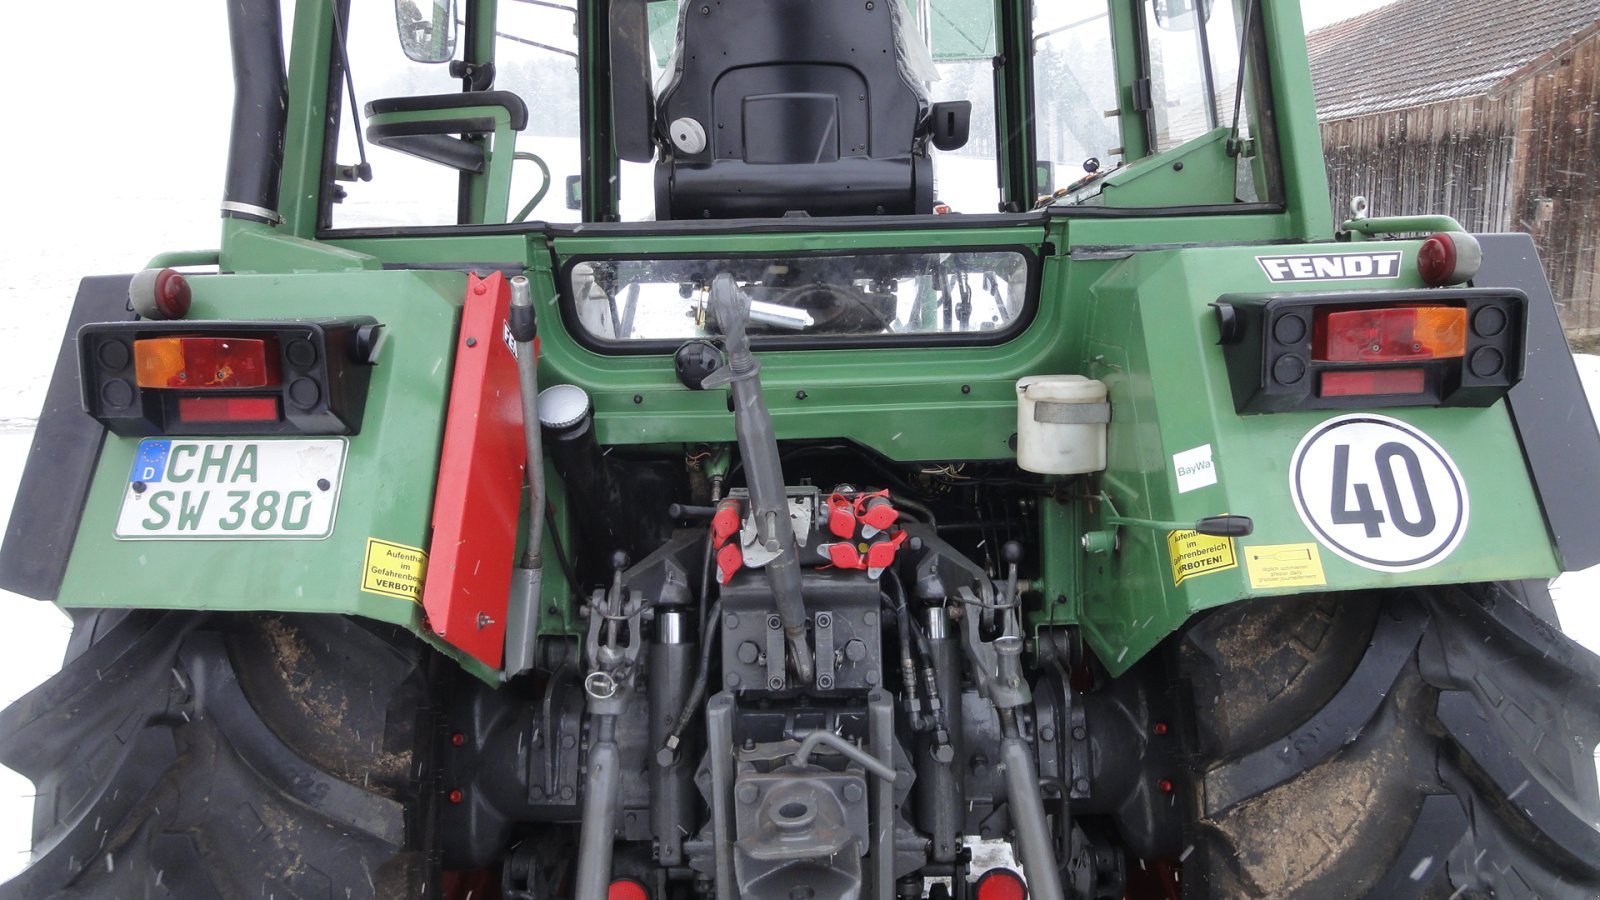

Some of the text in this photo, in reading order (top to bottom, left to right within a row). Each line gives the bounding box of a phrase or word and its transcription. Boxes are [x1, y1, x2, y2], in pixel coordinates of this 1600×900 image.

[1262, 254, 1399, 279] FENDT
[166, 444, 258, 484] CHA
[1177, 460, 1211, 477] BayWa
[142, 466, 156, 481] D
[1329, 441, 1437, 539] 40
[141, 490, 313, 531] SW 380
[1186, 541, 1197, 549] im
[386, 549, 422, 564] Aufentha
[400, 562, 411, 571] im
[376, 578, 421, 595] VERBOTE
